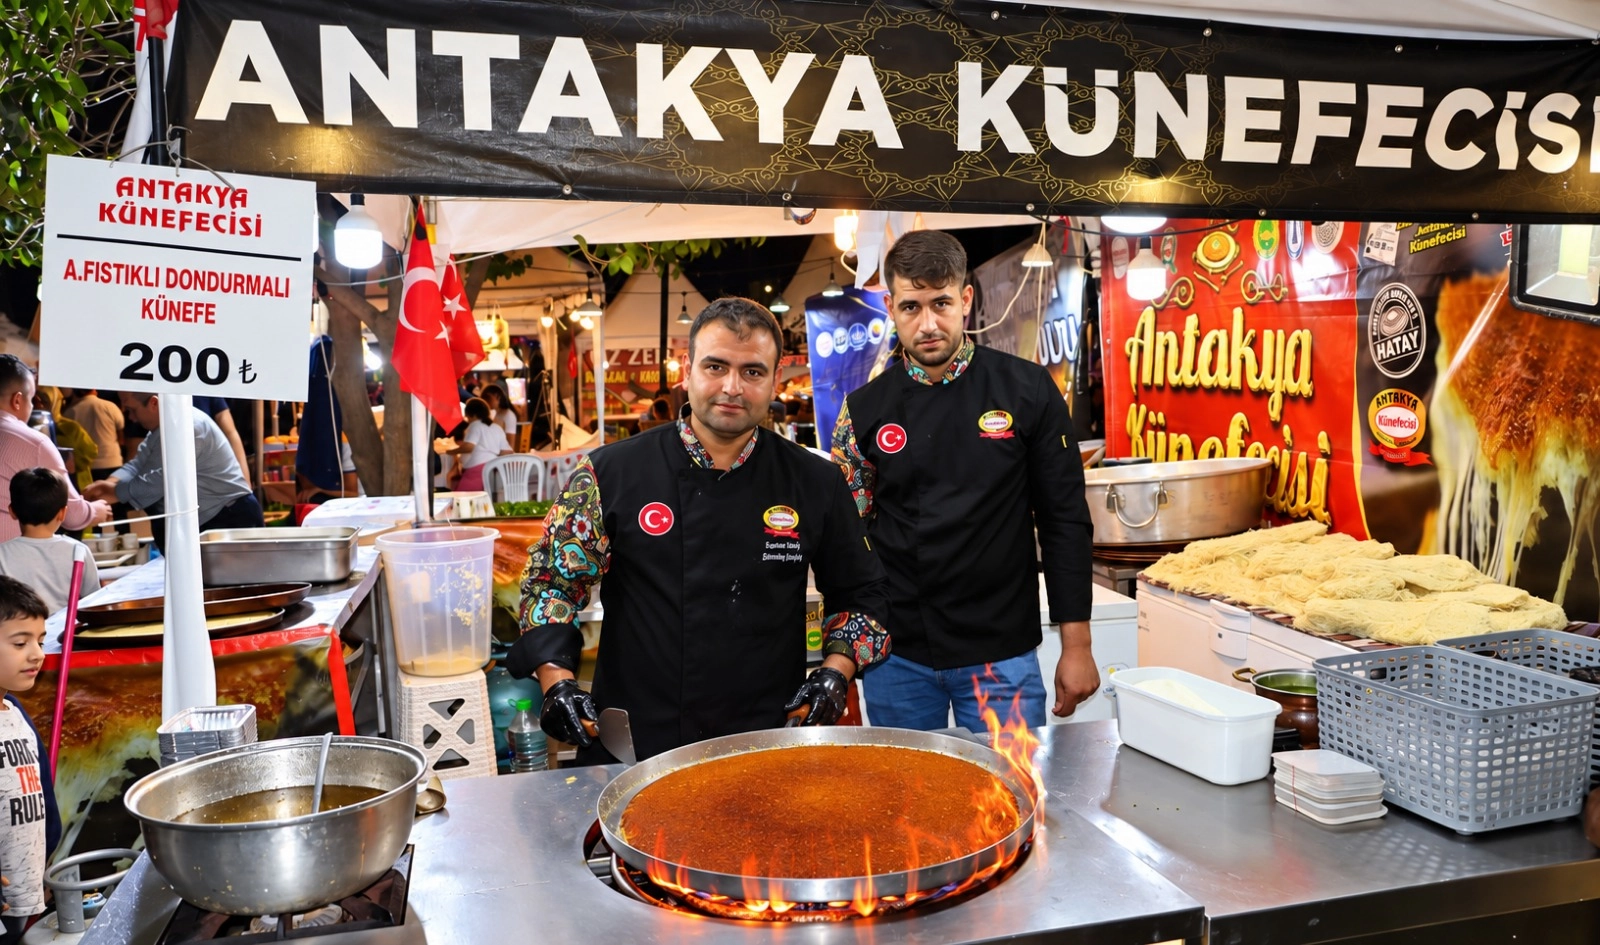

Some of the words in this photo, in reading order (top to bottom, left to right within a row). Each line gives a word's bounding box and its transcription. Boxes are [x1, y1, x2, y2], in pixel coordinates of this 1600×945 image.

[194, 19, 903, 150] ANTAKYA
[115, 176, 248, 210] ANTAKYA
[98, 200, 263, 238] KÜNEFECİSİ
[63, 258, 161, 289] A.FISTIKLI
[165, 267, 291, 299] DONDURMALI
[140, 294, 217, 325] KÜNEFE
[1376, 330, 1419, 362] HATAY
[119, 342, 230, 386] 200
[1125, 306, 1315, 422] Antakya
[1375, 391, 1419, 412] ANTAKYA
[1377, 414, 1418, 431] Künefecisi
[16, 765, 42, 794] THE
